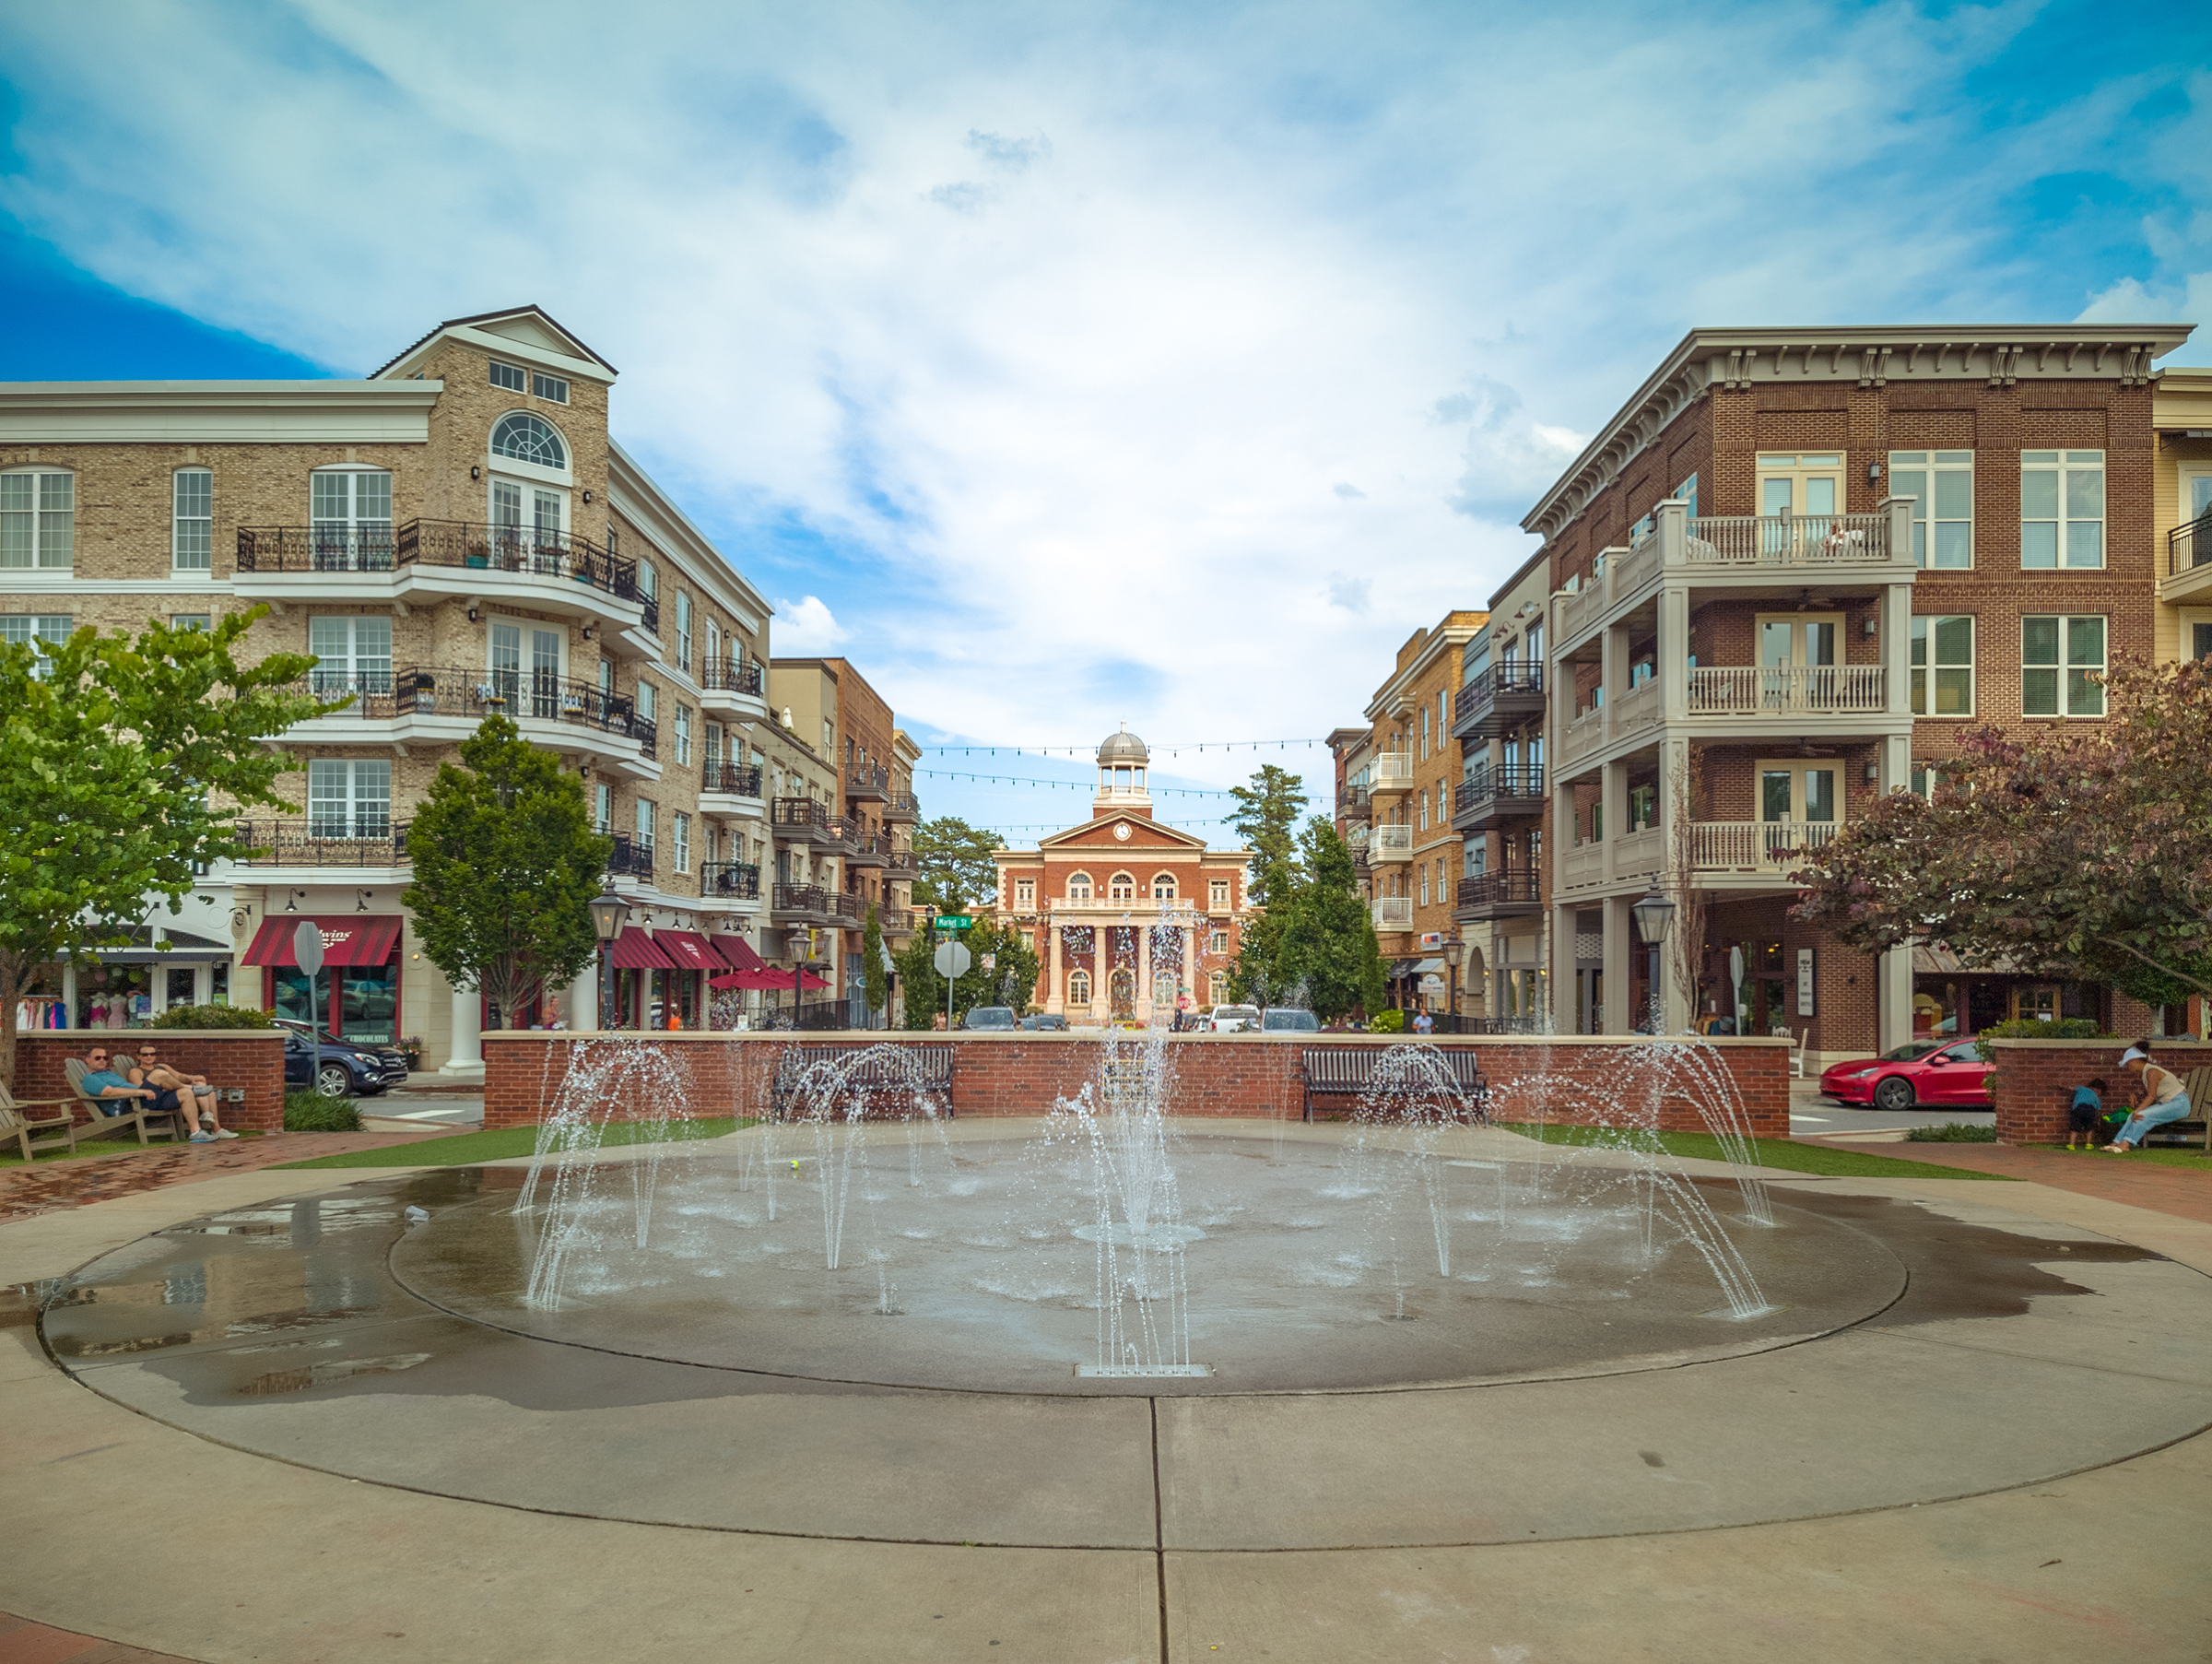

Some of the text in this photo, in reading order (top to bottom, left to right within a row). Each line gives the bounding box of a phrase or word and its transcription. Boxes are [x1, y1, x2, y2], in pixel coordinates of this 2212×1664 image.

[938, 918, 967, 926] Market St
[349, 1034, 389, 1043] CHOCOLATES
